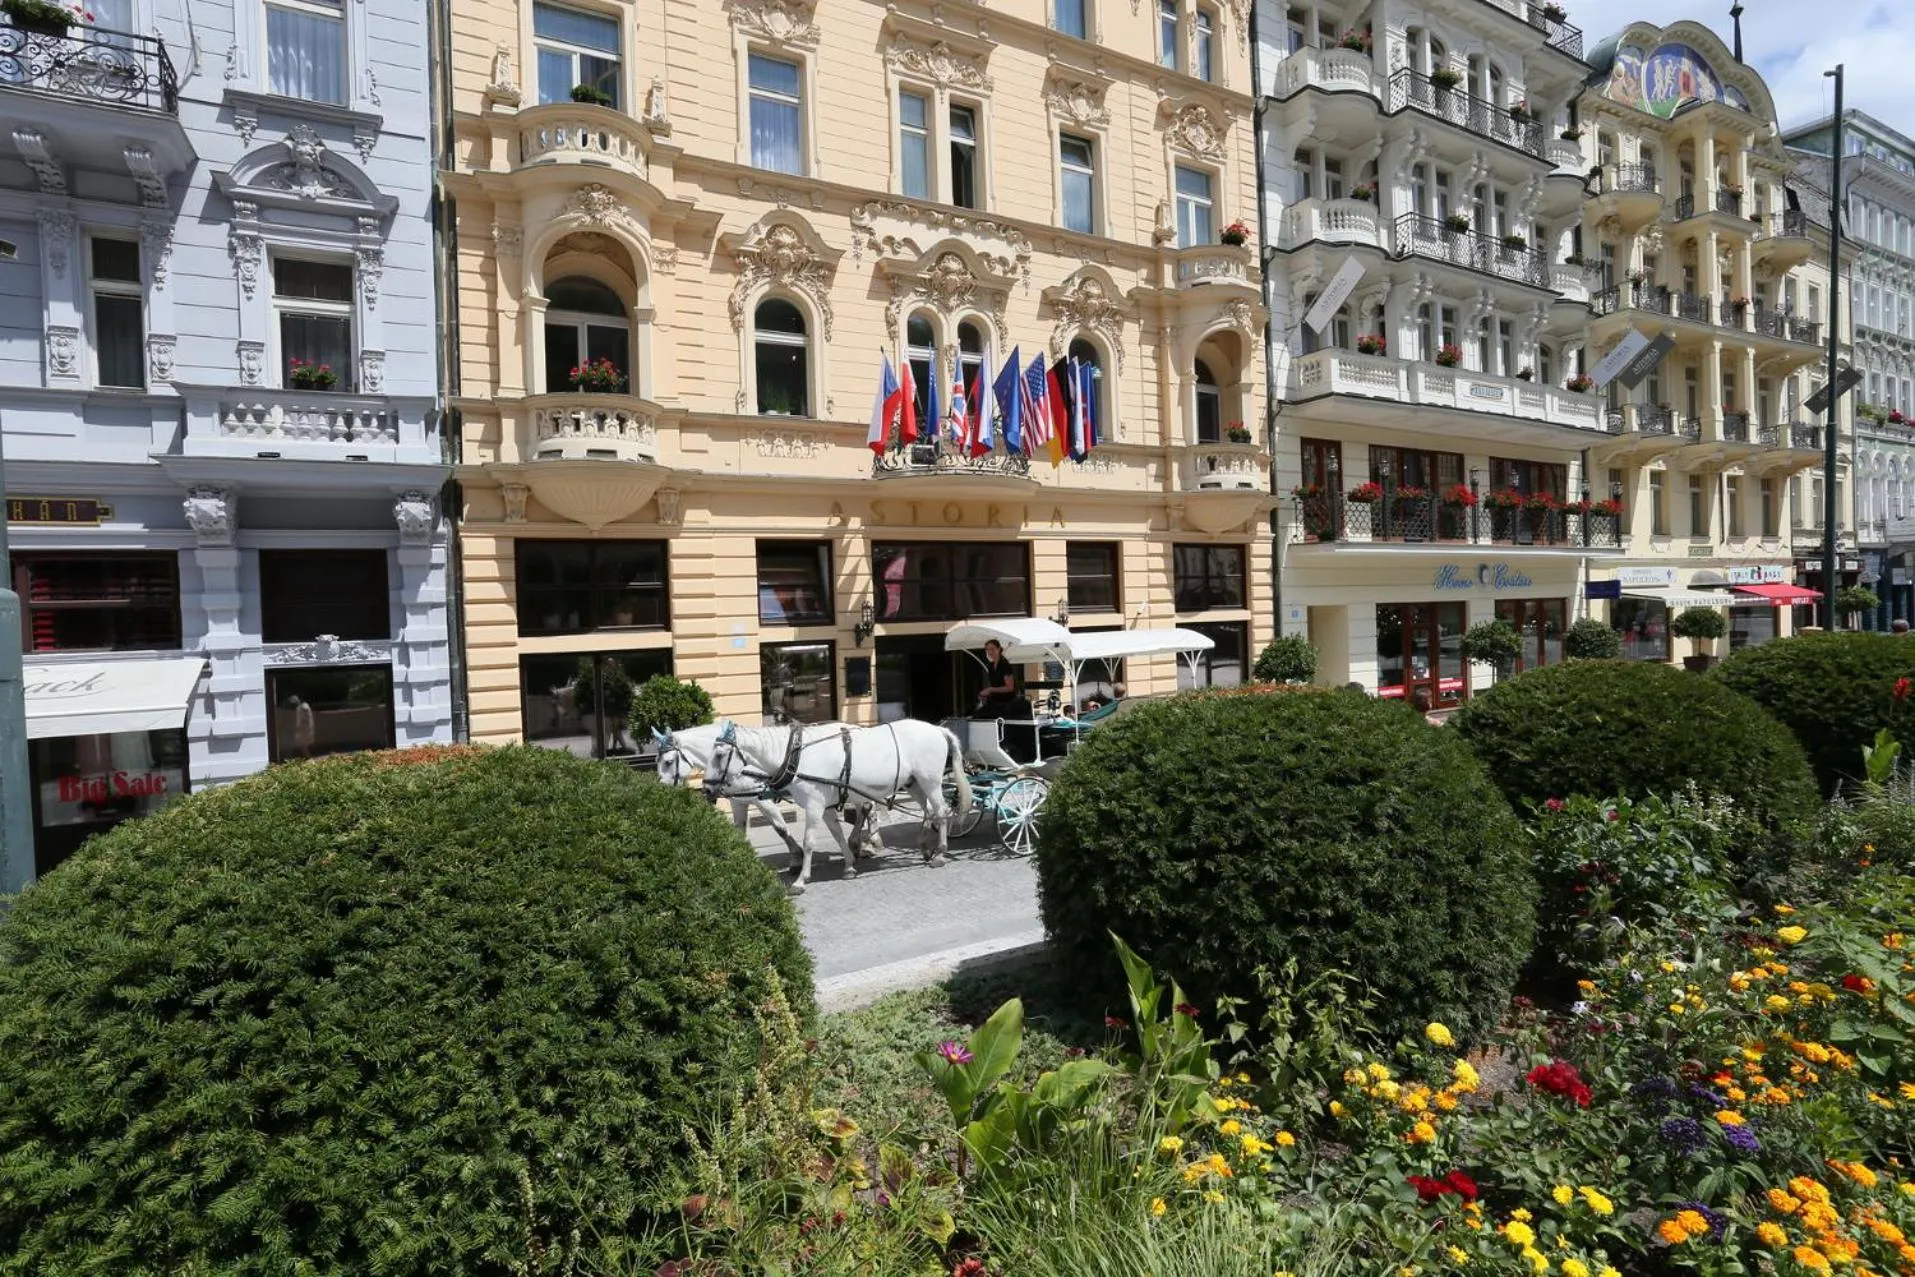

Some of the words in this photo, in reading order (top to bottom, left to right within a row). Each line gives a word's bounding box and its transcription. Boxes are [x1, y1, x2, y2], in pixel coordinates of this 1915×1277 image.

[827, 500, 1066, 528] ASTORIA
[24, 667, 106, 694] ack
[58, 773, 109, 805] Big
[111, 769, 169, 799] Sale
